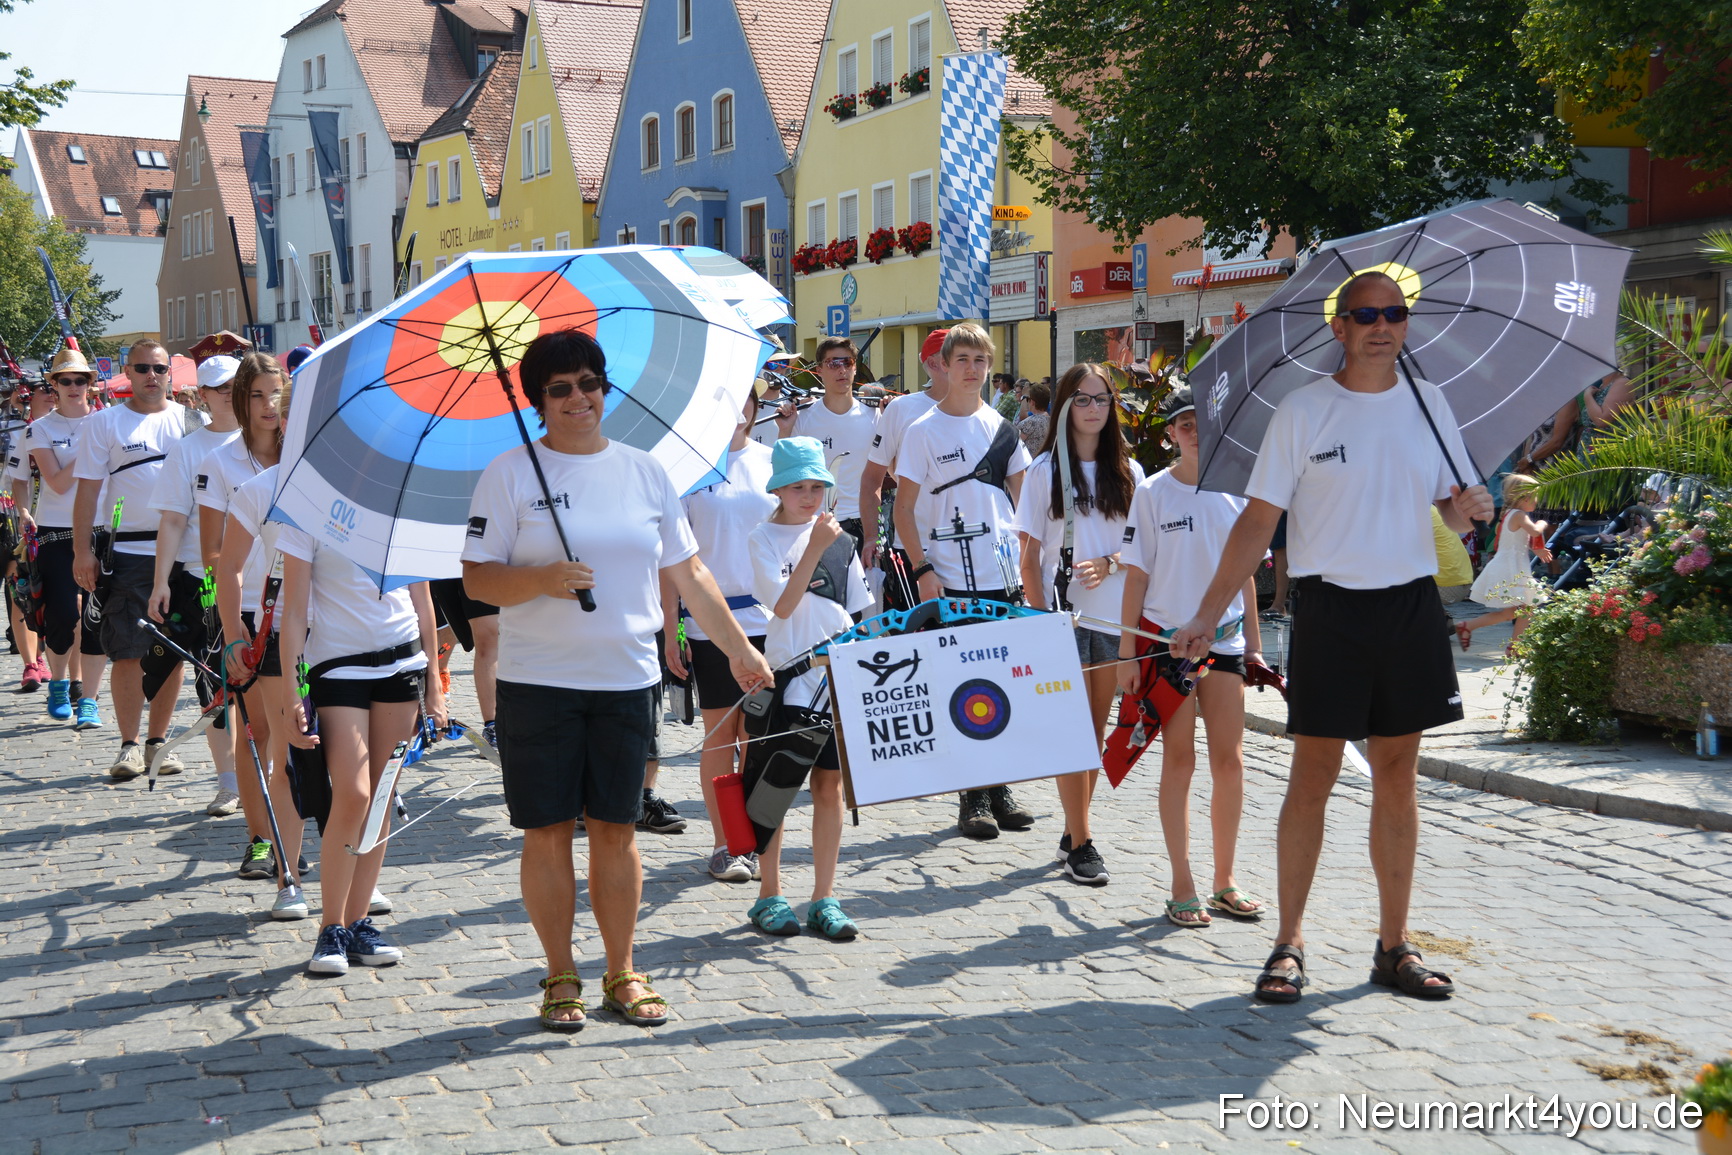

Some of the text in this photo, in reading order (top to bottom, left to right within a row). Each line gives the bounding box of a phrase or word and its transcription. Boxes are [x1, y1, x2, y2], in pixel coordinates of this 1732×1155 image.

[995, 208, 1014, 218] KINO
[440, 225, 494, 249] HOTEL Lehmeier
[770, 230, 785, 245] CAFÉ
[1135, 249, 1144, 283] P
[1109, 268, 1131, 281] DER
[992, 281, 1027, 297] RIALTO KINO
[1038, 256, 1046, 315] KINO
[1071, 277, 1084, 293] DER
[832, 308, 844, 335] P
[942, 452, 960, 461] RING
[1316, 450, 1339, 461] RING
[1167, 520, 1188, 529] RING
[938, 635, 958, 647] DA
[1011, 665, 1033, 678] MA
[862, 683, 929, 705] BOGEN
[1035, 680, 1072, 695] GERN
[865, 699, 930, 717] SCHÜTZEN
[867, 711, 934, 745] NEU
[872, 738, 936, 761] MARKT
